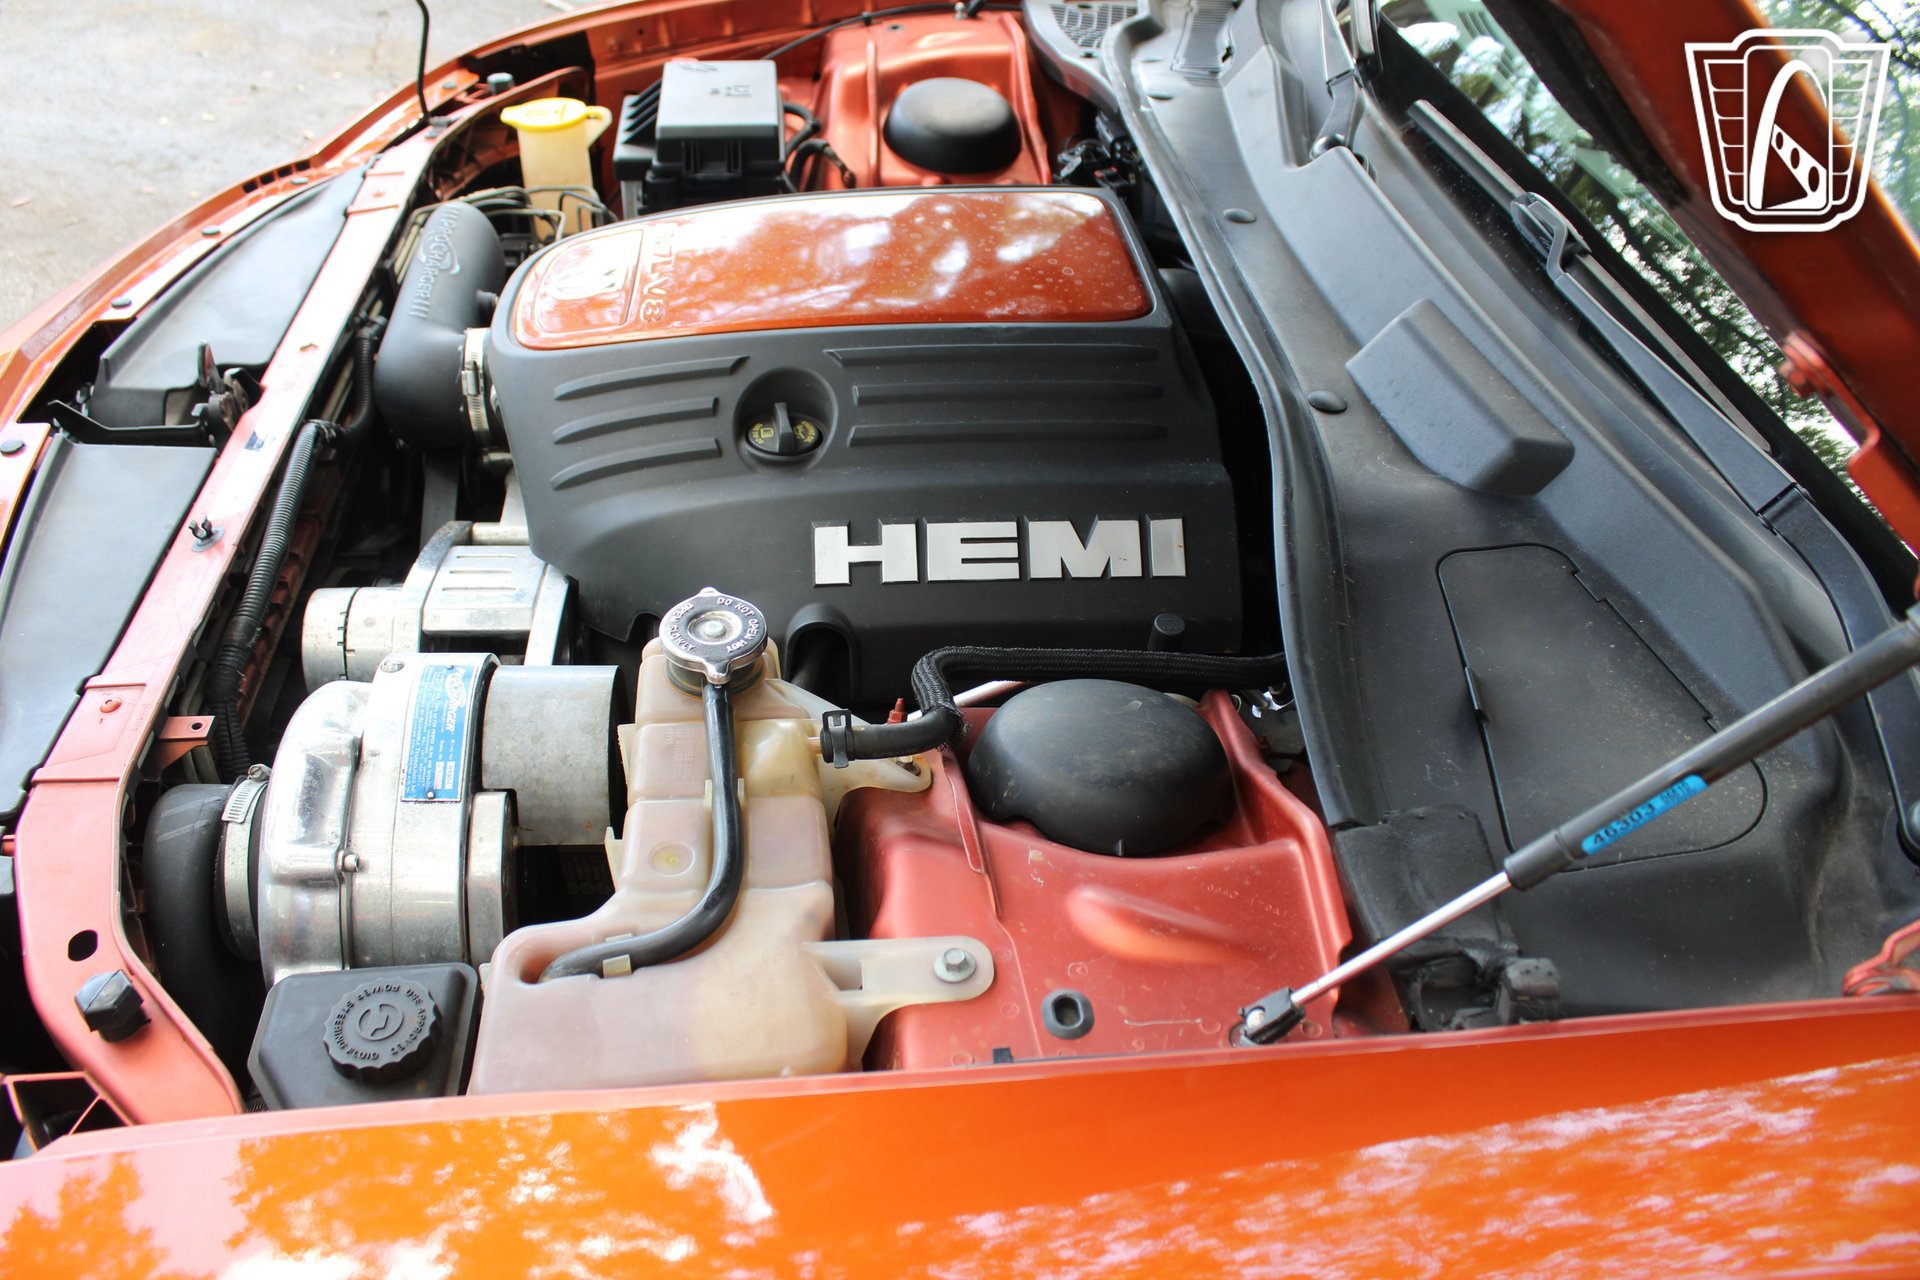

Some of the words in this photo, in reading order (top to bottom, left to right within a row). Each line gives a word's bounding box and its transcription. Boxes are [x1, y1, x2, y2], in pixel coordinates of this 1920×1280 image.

[414, 218, 457, 299] PROCHARGER
[812, 516, 1188, 587] HEMI
[669, 602, 694, 622] OPEN
[717, 597, 733, 606] DO
[735, 603, 754, 616] NOT
[667, 624, 696, 651] SLOWLY
[744, 618, 759, 640] OPEN
[1593, 803, 1656, 844] 46303
[347, 1048, 380, 1061] FLUID
